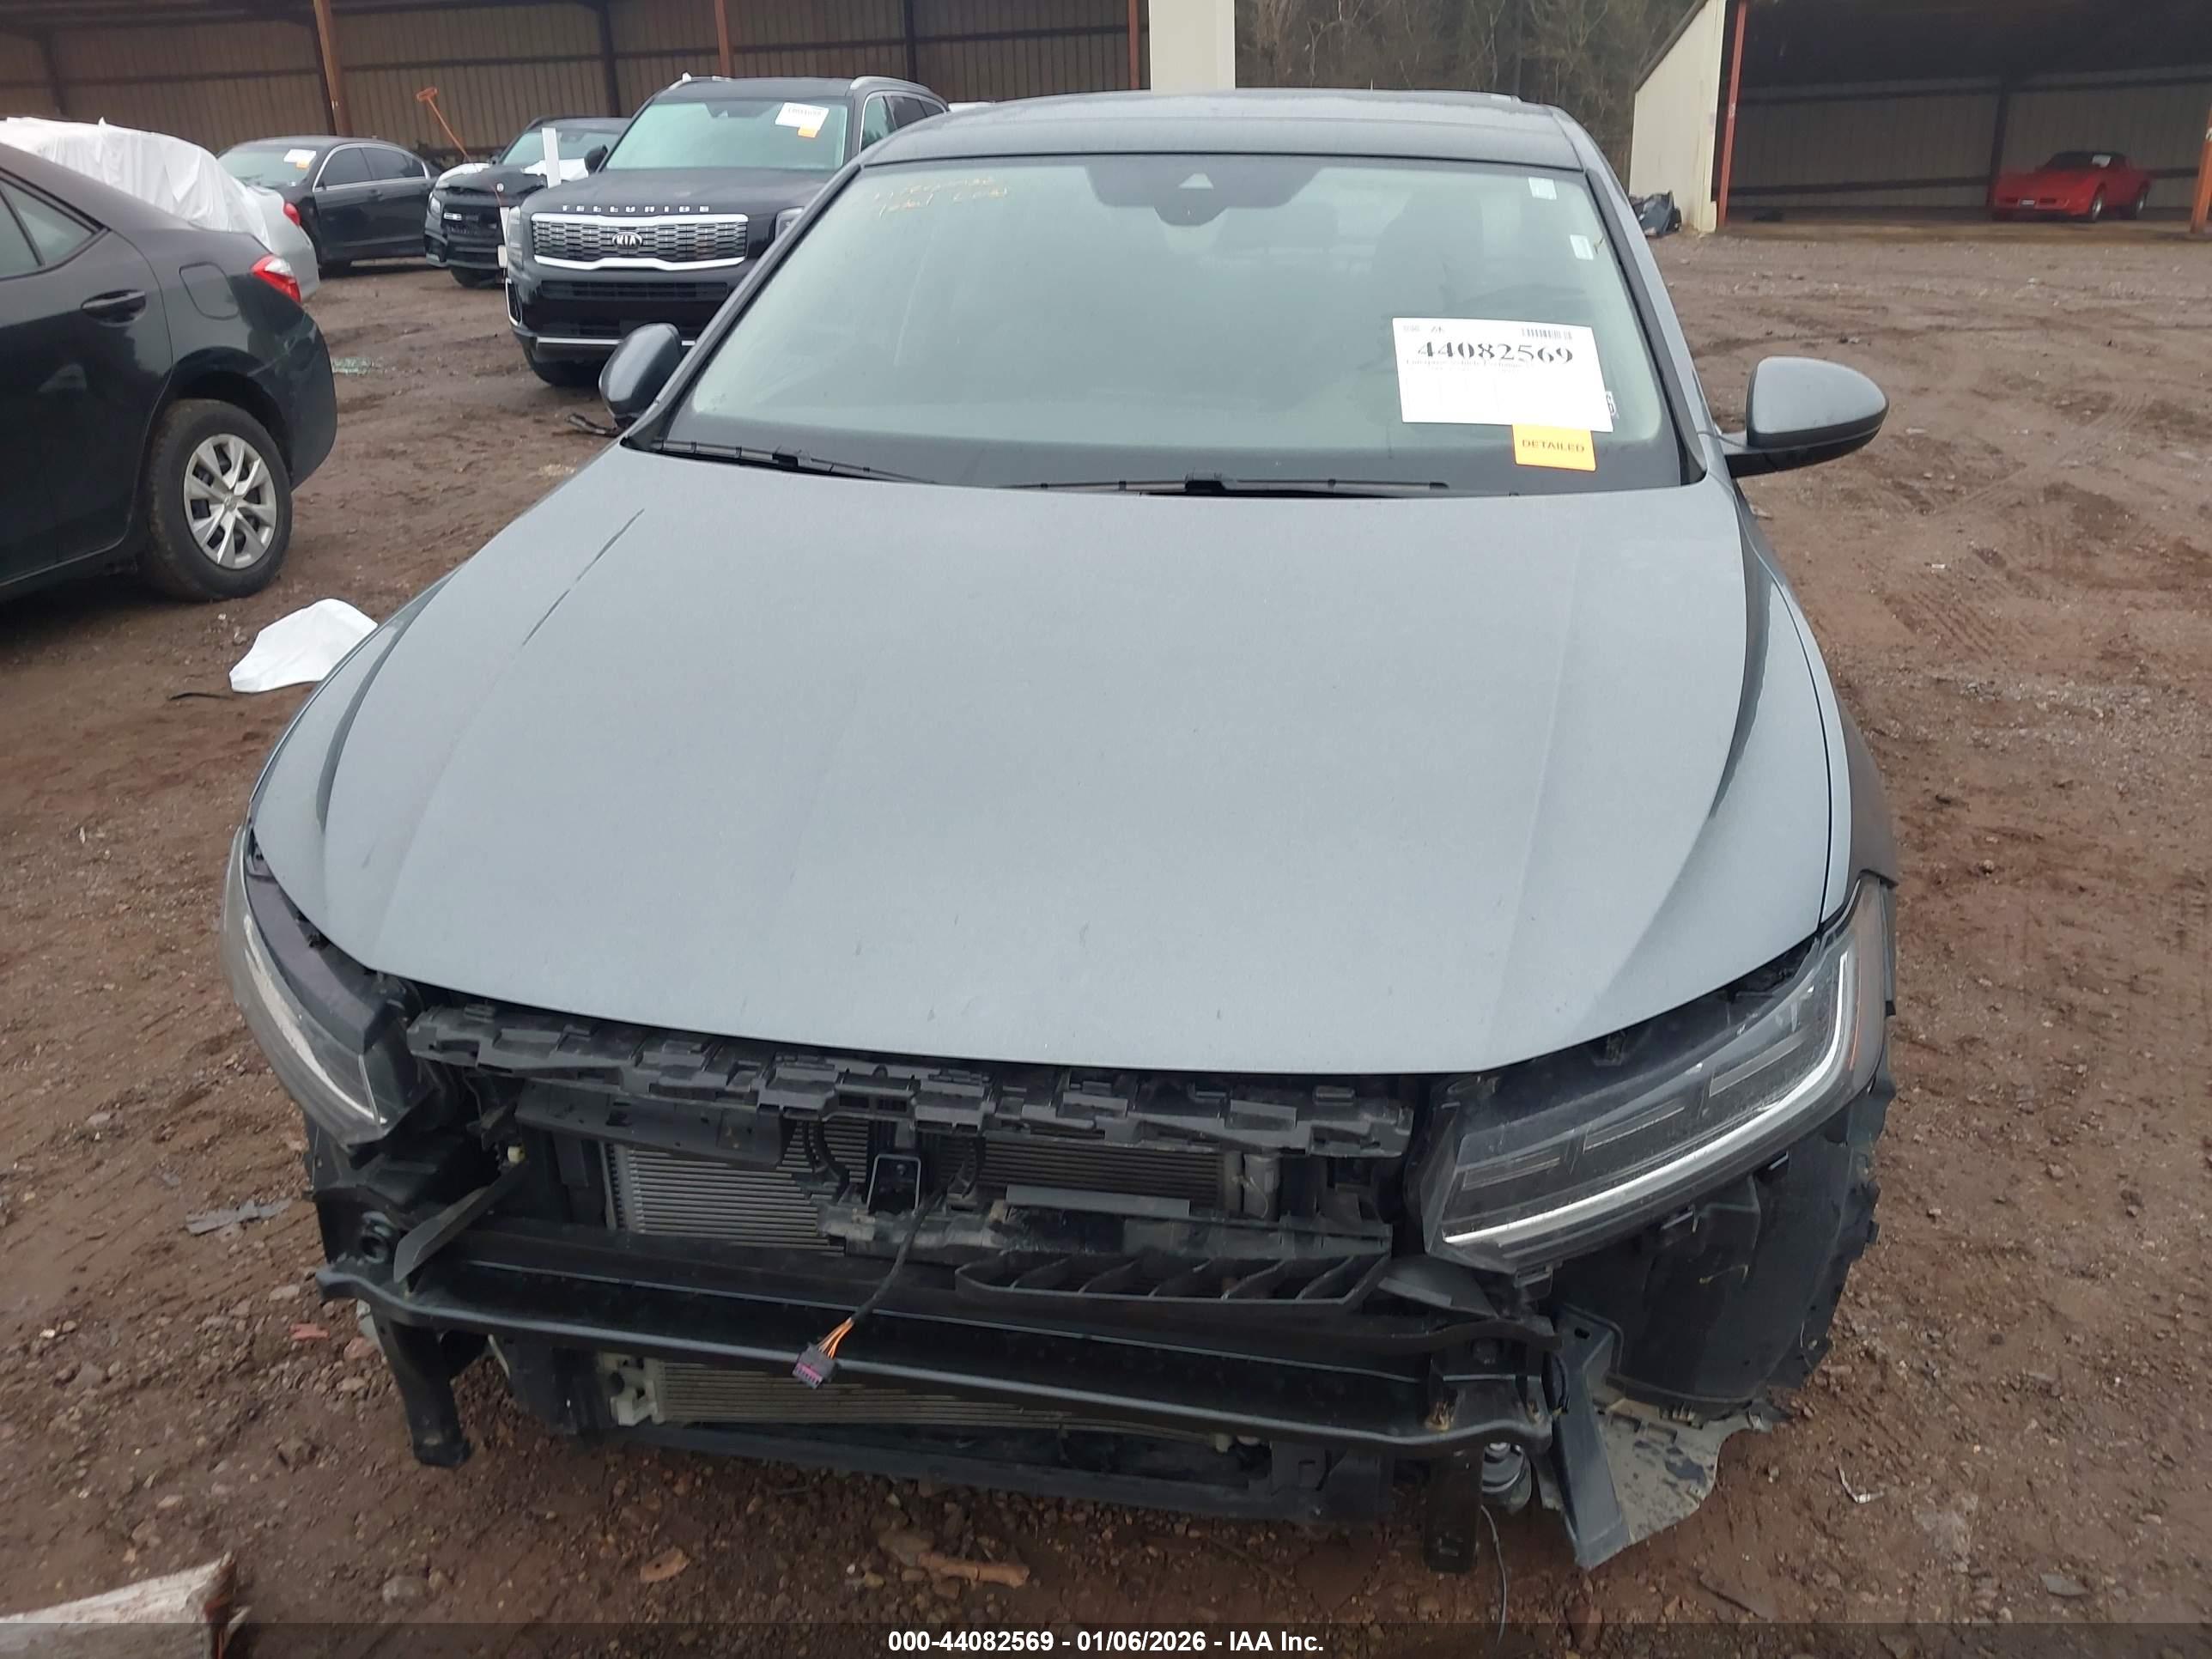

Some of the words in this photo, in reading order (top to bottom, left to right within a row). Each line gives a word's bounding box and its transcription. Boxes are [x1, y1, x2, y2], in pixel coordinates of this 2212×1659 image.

[562, 204, 710, 214] TELLURIDE
[615, 234, 638, 246] KIA
[1418, 342, 1573, 364] 44082569
[1521, 439, 1586, 453] DETAILED
